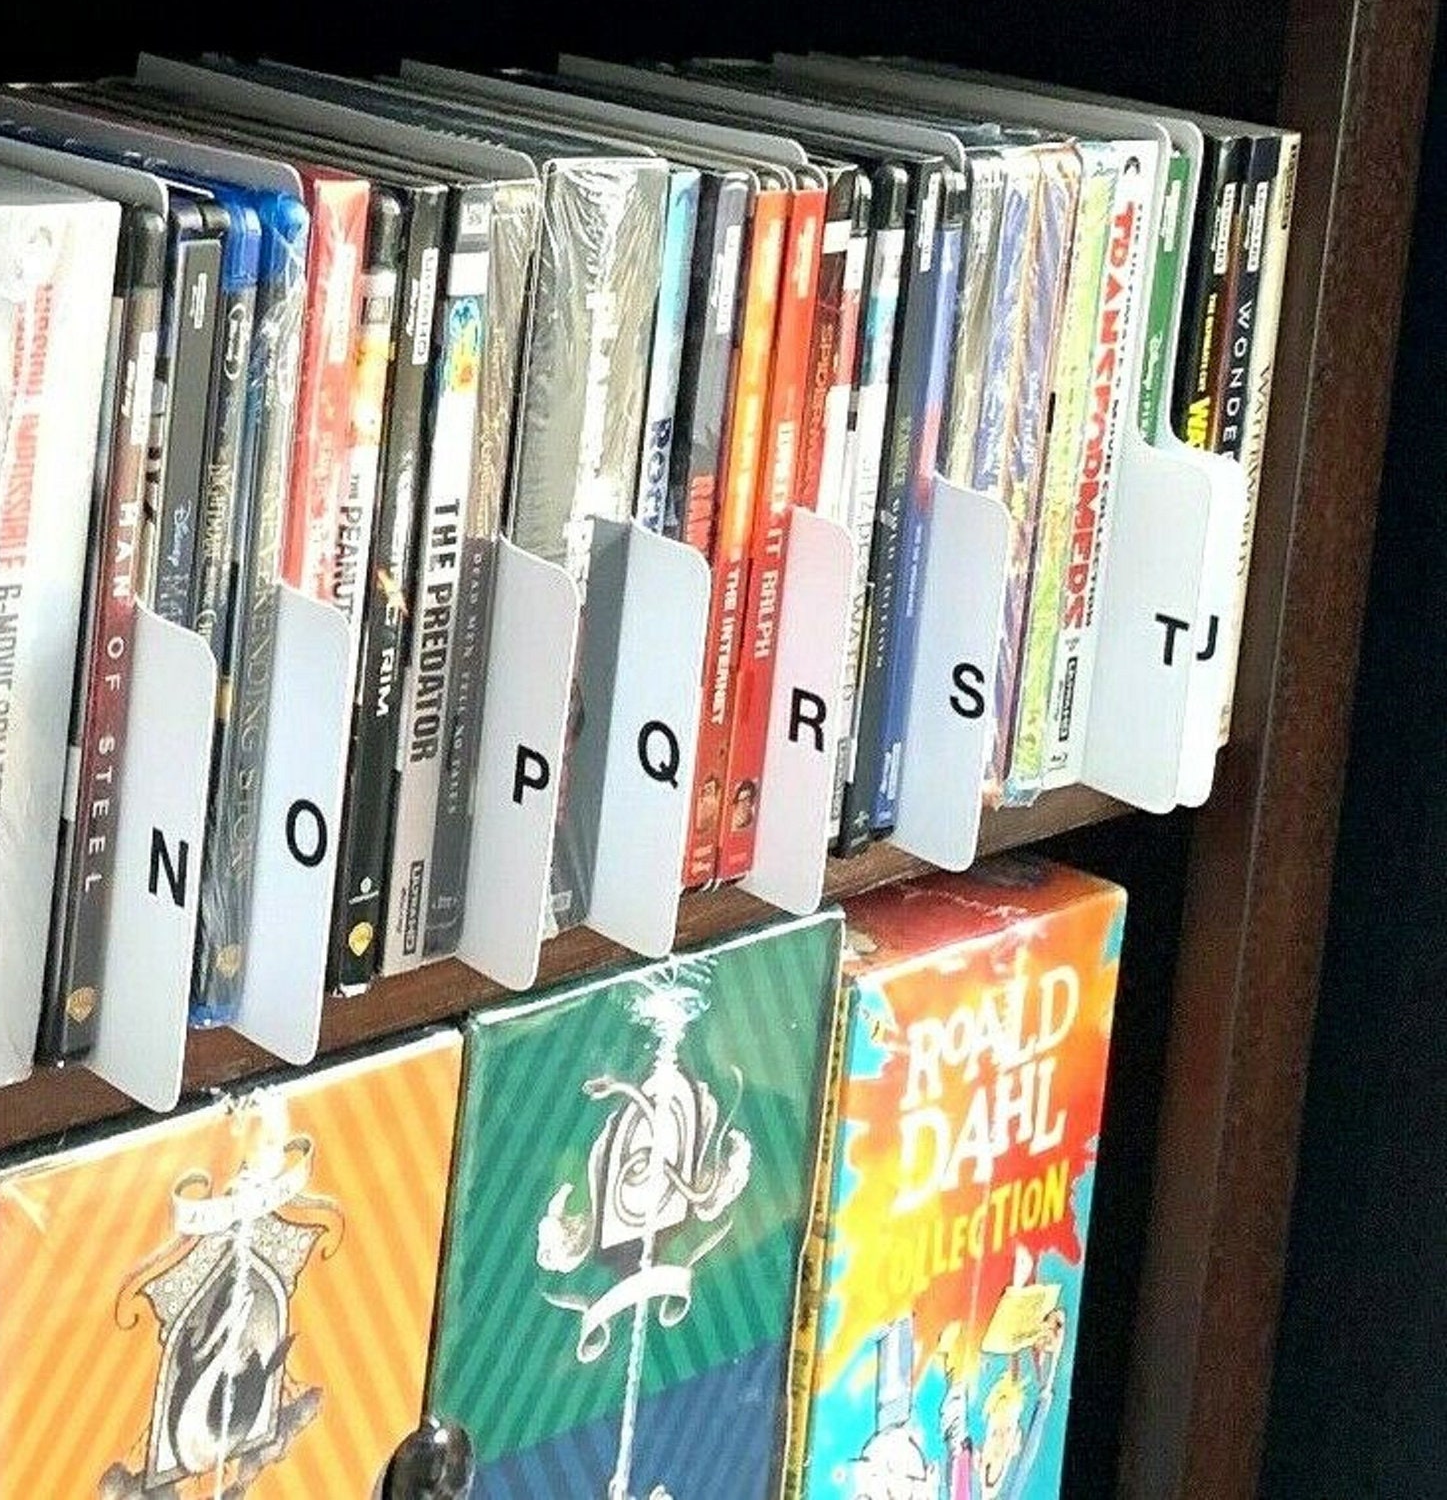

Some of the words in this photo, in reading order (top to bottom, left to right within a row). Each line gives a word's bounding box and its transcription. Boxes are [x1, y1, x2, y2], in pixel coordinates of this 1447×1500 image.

[112, 503, 136, 597] MAN
[428, 498, 461, 573] THE
[722, 569, 740, 611] THE
[754, 567, 780, 659] RALPH
[104, 635, 125, 692] OF
[409, 582, 454, 764] PREDATOR
[711, 616, 736, 725] INTERNET
[1154, 612, 1190, 667] T
[375, 647, 397, 717] RIM
[949, 661, 986, 720] S
[636, 719, 681, 790] Q
[788, 687, 827, 753] R
[512, 744, 550, 805] P
[84, 736, 116, 892] STEEL
[284, 798, 329, 868] O
[148, 826, 190, 908] N
[903, 962, 1081, 1111] ROALD
[894, 1056, 1069, 1214] DAHL
